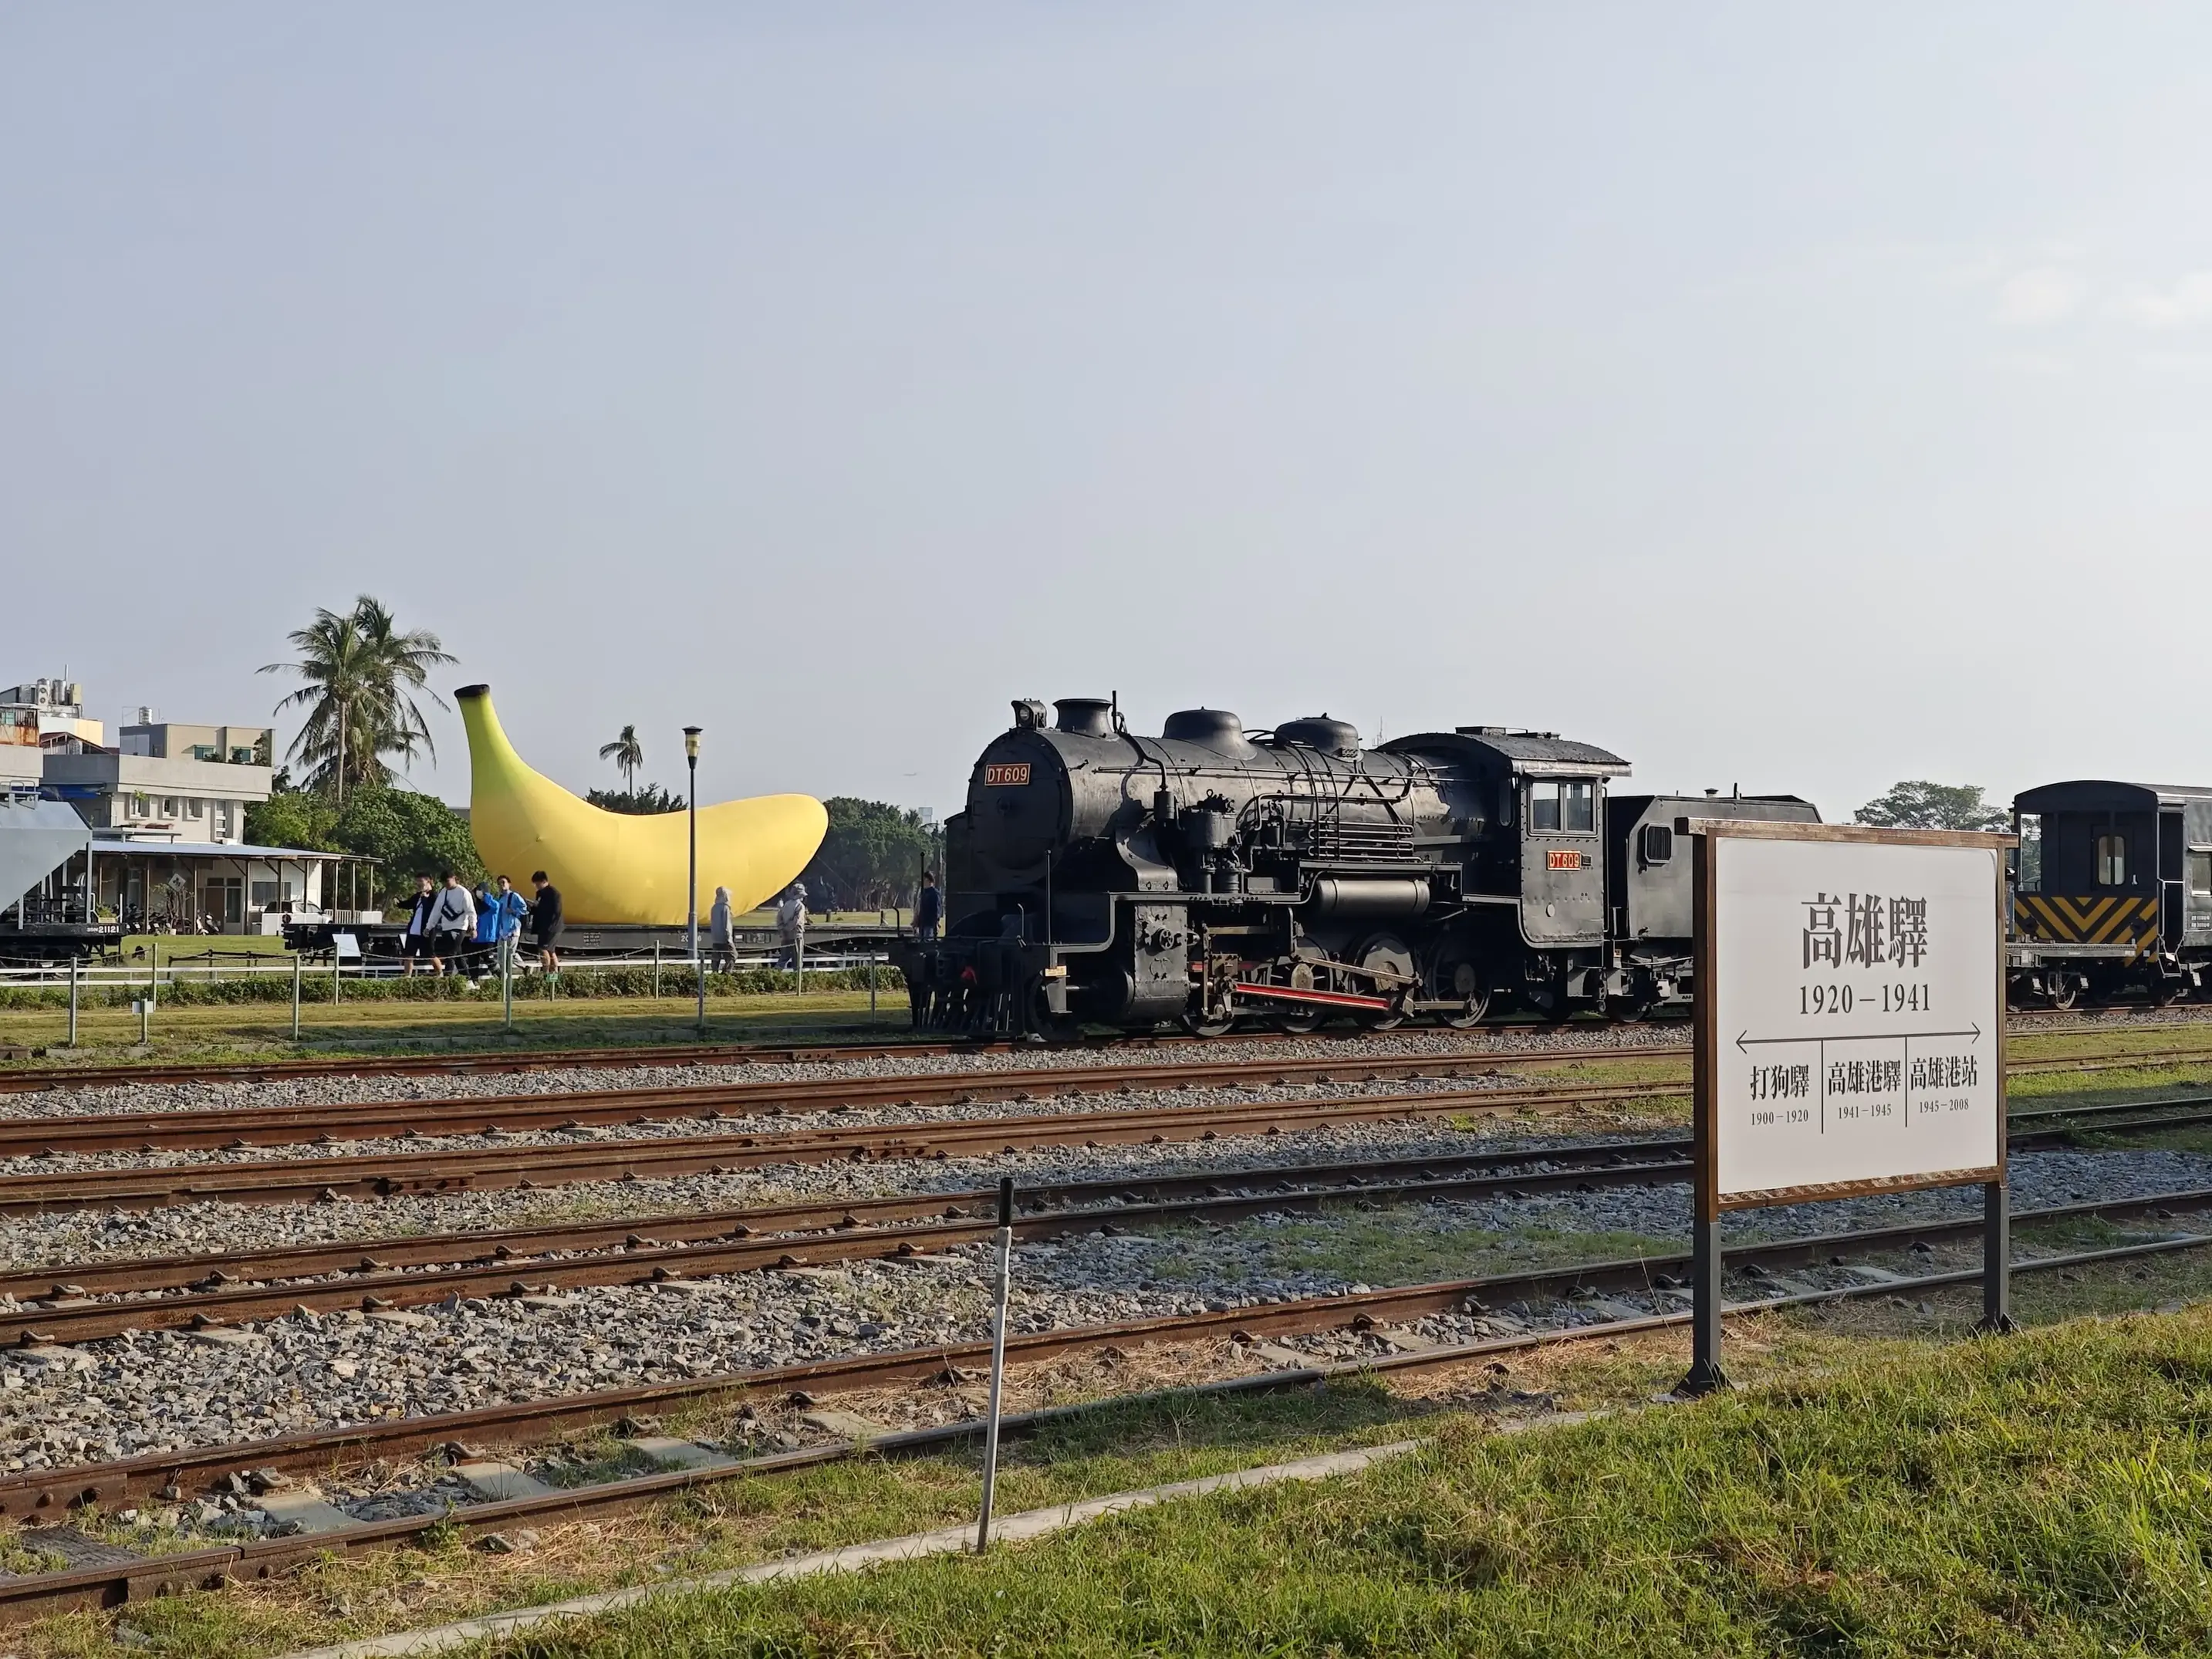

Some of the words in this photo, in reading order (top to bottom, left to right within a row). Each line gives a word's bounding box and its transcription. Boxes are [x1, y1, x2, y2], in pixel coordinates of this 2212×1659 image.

[988, 767, 1028, 782] DT609
[1549, 853, 1579, 867] DT609
[1801, 892, 1928, 970] 高雄驛
[1750, 1064, 1810, 1101] 打狗驛
[1827, 1059, 1902, 1096] 高雄港驛
[1910, 1054, 1977, 1091] 高雄港站
